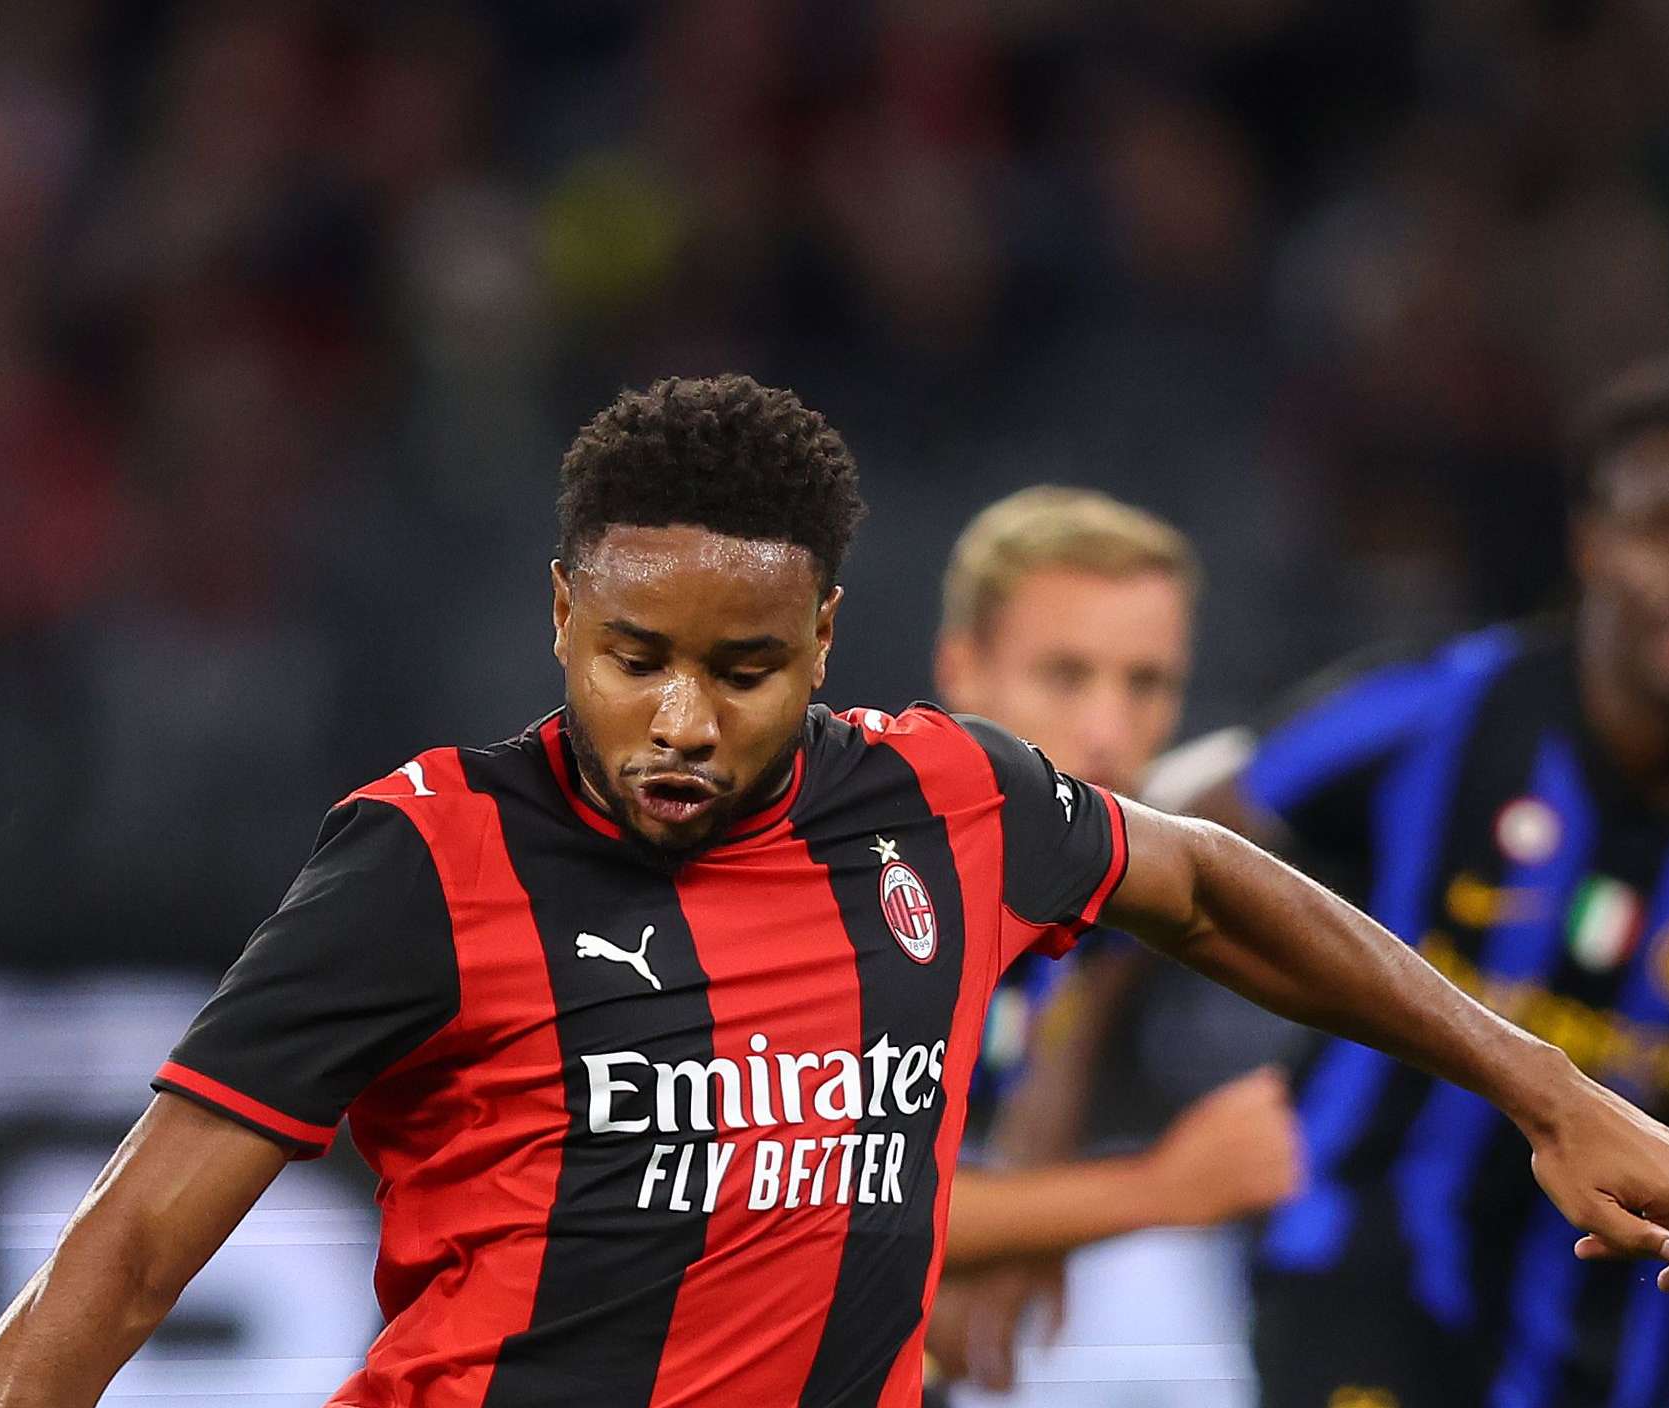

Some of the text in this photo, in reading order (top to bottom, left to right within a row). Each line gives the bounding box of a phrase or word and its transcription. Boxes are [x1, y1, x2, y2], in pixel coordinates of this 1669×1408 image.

[888, 869, 915, 890] ACM
[908, 939, 931, 951] 1899
[580, 1033, 945, 1134] Emirates
[636, 1132, 906, 1213] FLY BETTER
